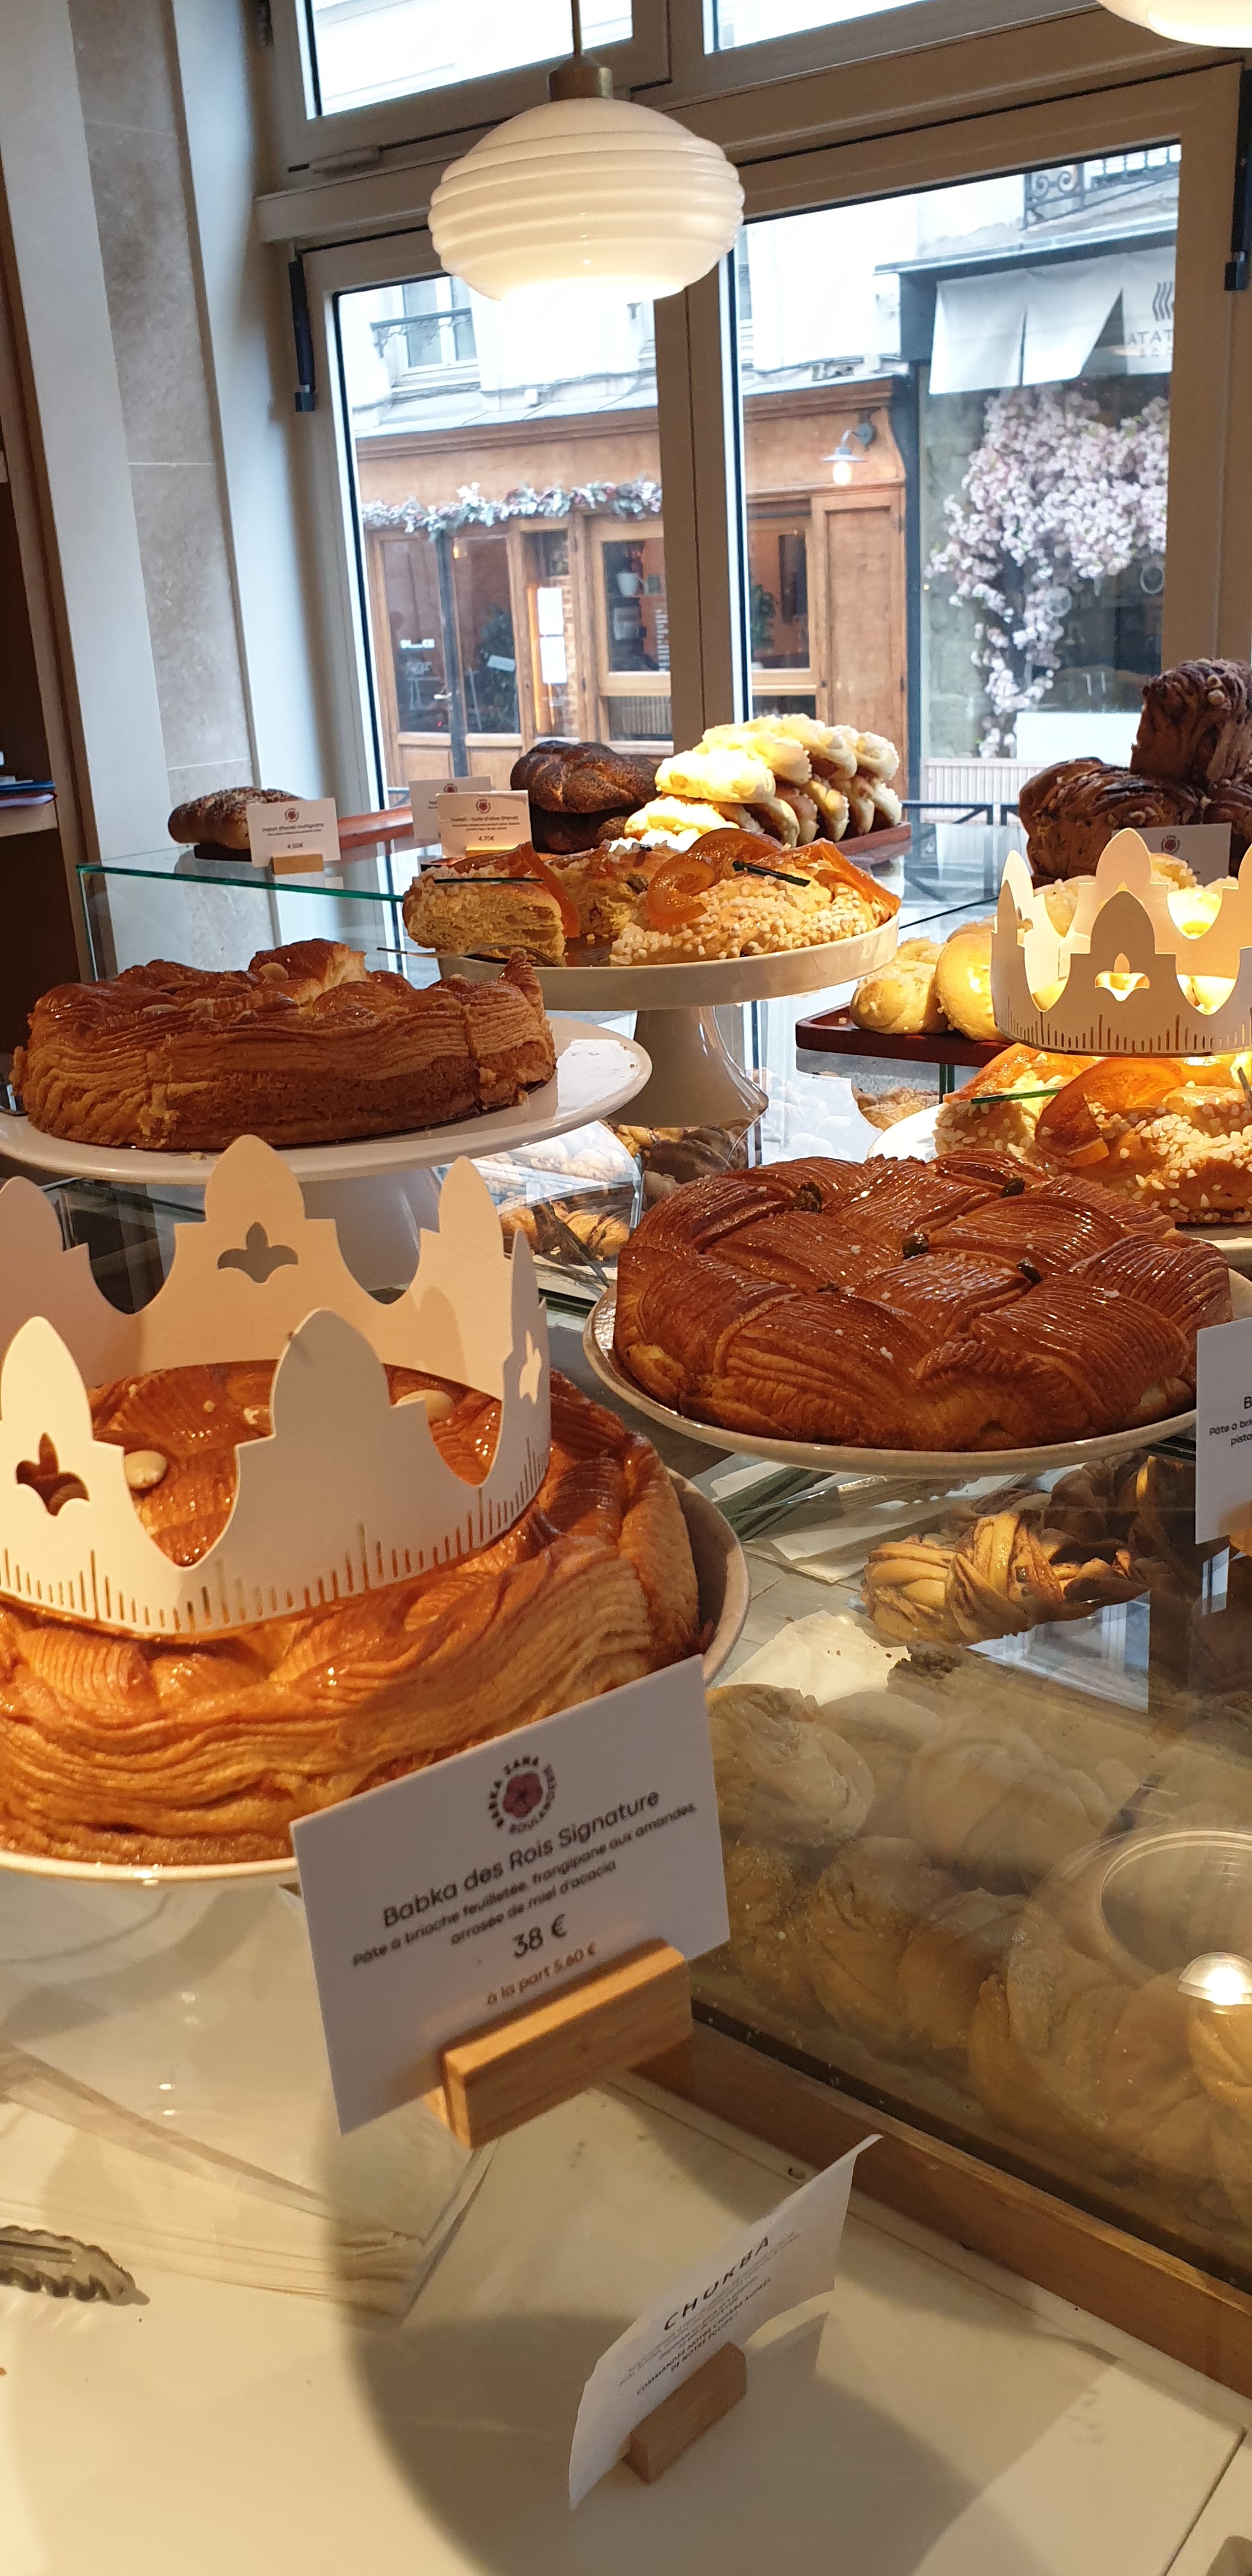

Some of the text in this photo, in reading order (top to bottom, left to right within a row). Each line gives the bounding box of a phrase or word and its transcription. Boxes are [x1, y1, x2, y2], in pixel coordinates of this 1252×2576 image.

[1209, 1425, 1230, 1436] Pâte
[383, 1791, 659, 1928] Babka des Rois Signature
[608, 1829, 633, 1850] aux
[450, 1913, 505, 1947] arrosée
[507, 1901, 526, 1919] de
[528, 1884, 557, 1908] miel
[512, 1913, 569, 1959] 38 €
[500, 1983, 516, 1999] la
[518, 1965, 551, 1993] part
